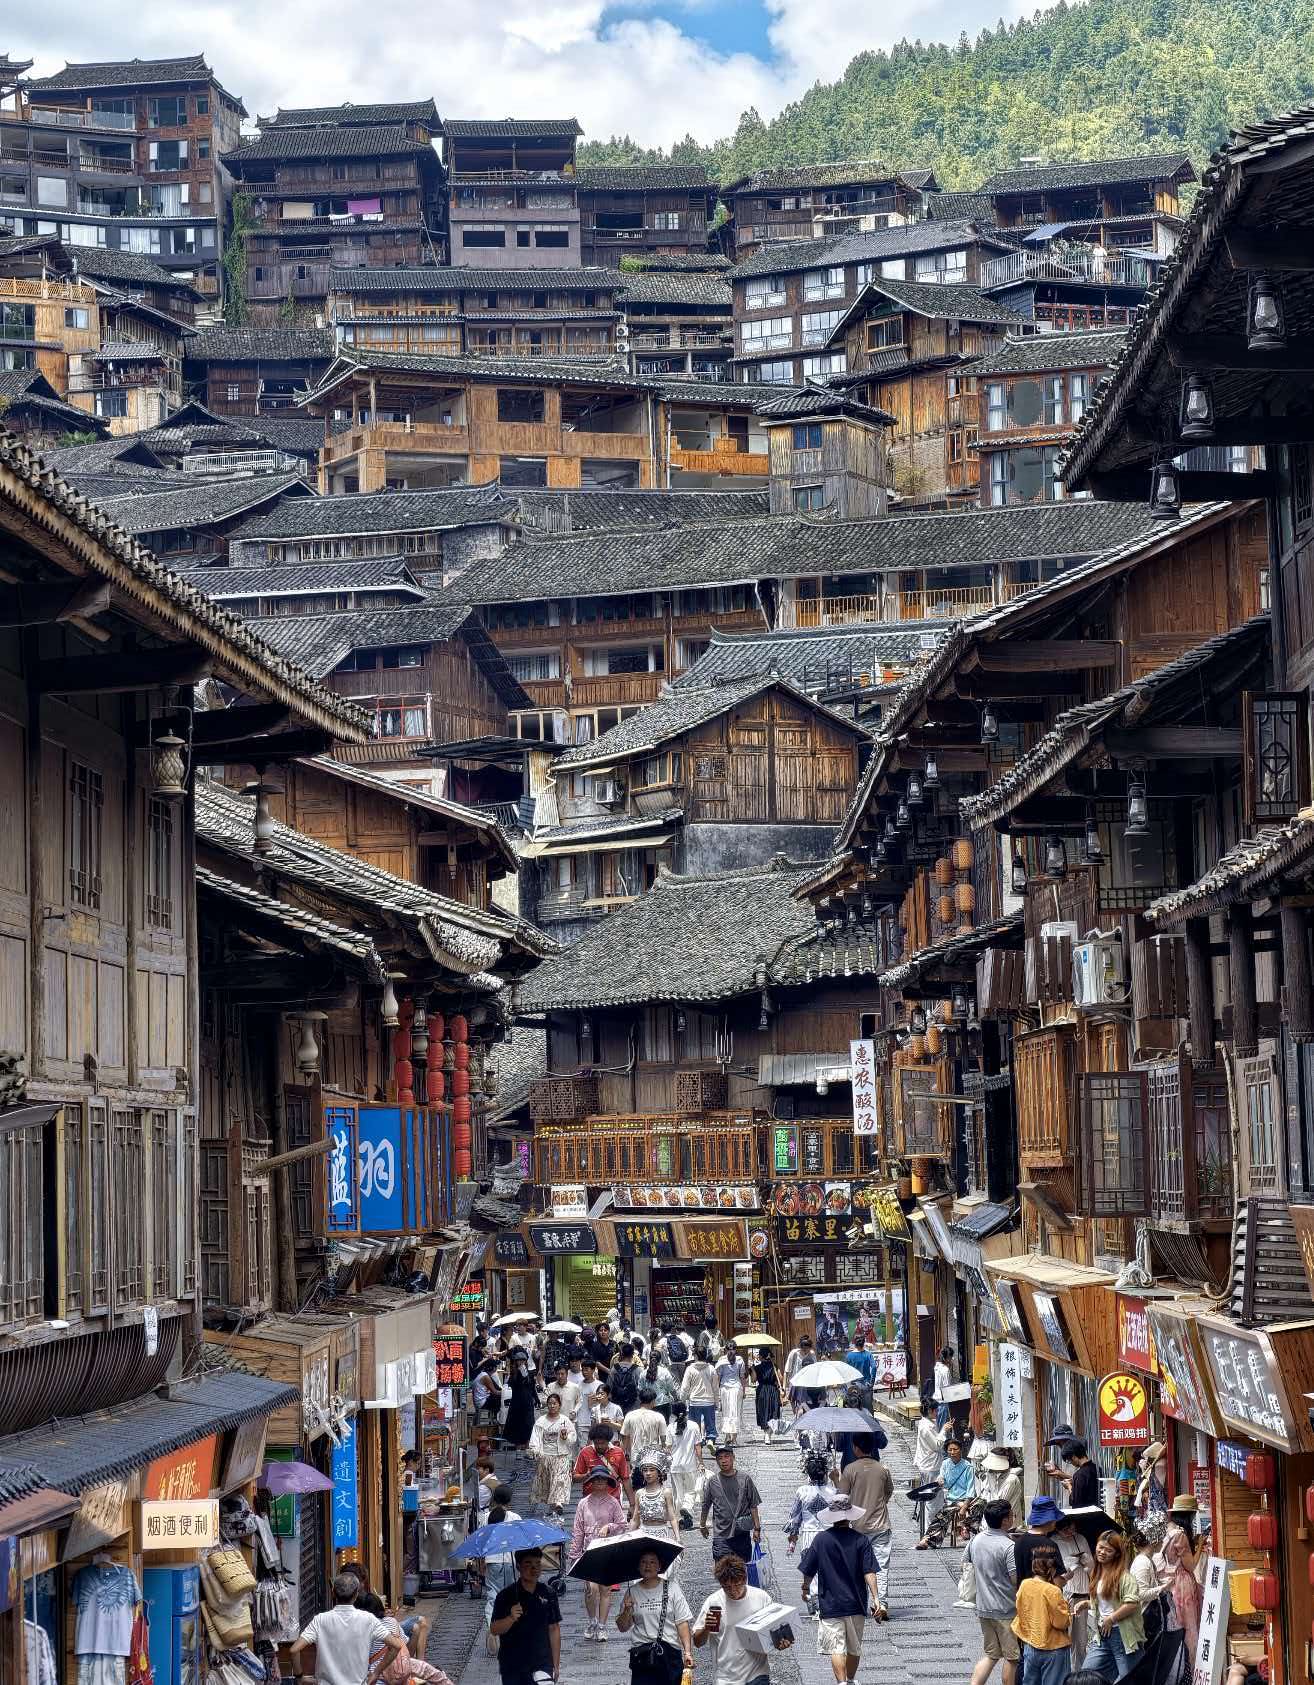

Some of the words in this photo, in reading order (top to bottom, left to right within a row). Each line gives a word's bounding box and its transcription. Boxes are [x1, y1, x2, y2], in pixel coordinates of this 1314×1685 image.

[854, 1044, 875, 1131] 惠农酸汤
[1101, 1428, 1148, 1440] 正新鸡排
[147, 1514, 208, 1537] 烟酒便利
